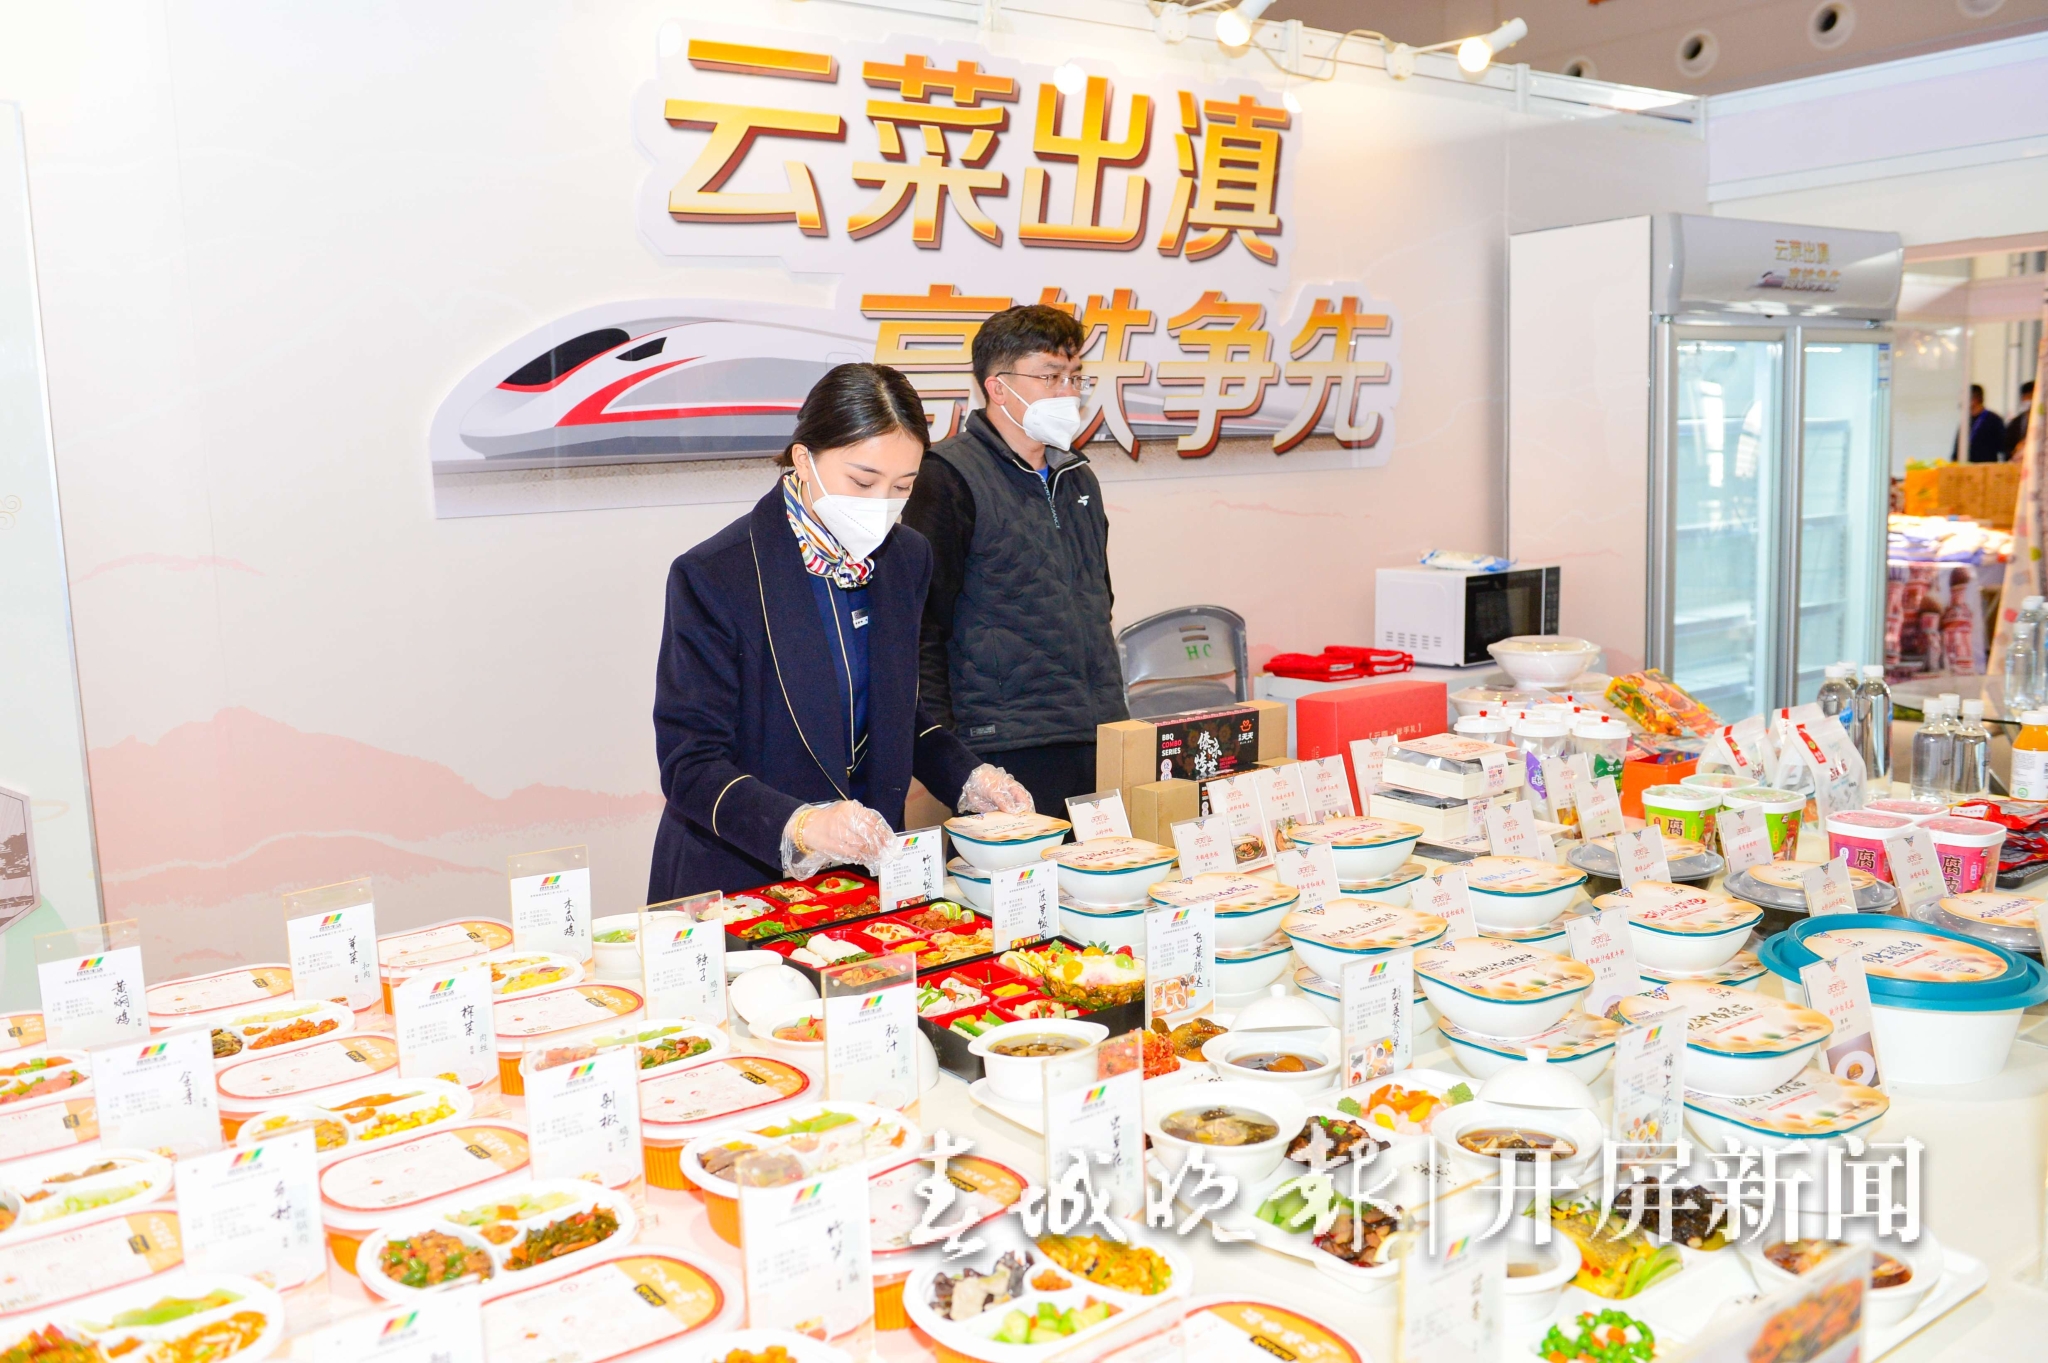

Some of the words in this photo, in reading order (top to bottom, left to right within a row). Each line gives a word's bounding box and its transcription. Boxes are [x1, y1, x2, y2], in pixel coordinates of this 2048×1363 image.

[663, 38, 1291, 265] 云菜出滇
[1161, 733, 1174, 741] BBQ
[1161, 739, 1182, 748] COMBO
[1161, 747, 1181, 757] SERIES
[1856, 849, 1875, 869] 腐
